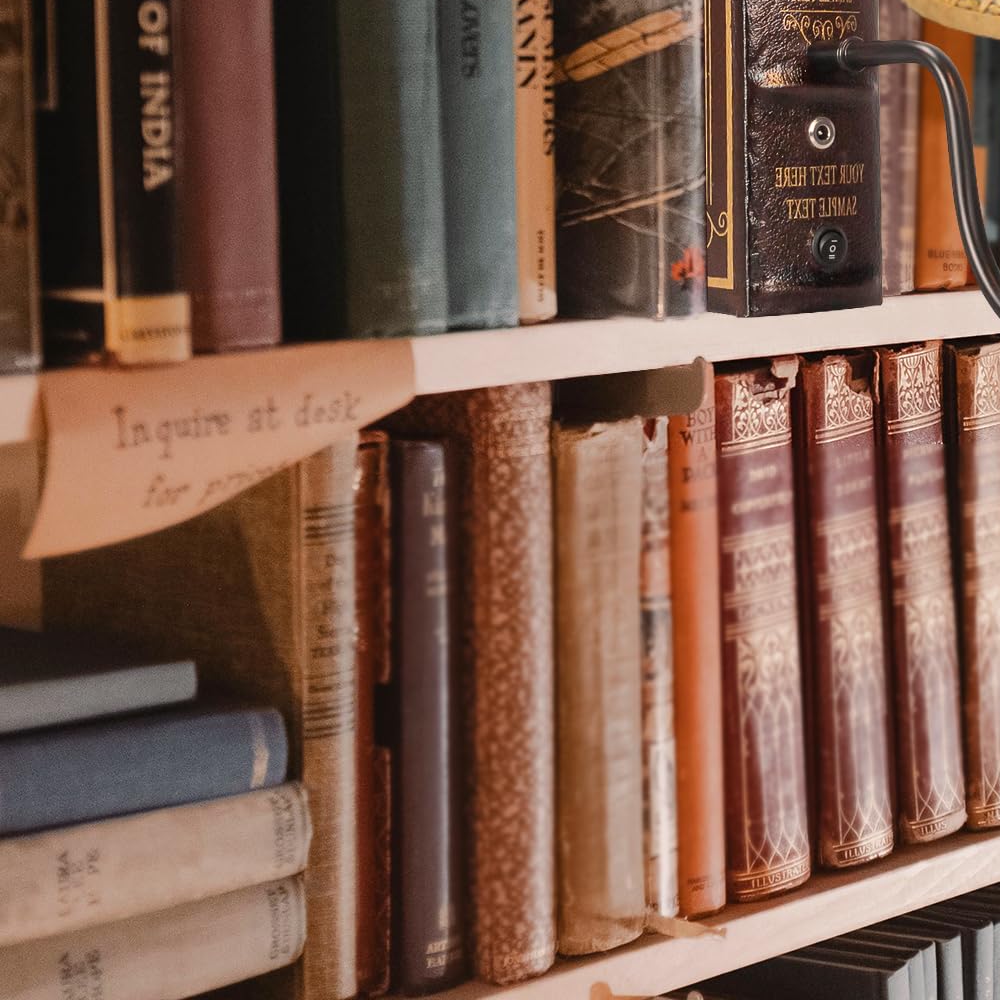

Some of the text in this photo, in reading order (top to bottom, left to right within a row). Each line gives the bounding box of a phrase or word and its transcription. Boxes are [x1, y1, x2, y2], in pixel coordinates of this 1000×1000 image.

[137, 0, 170, 57] OF
[139, 71, 173, 192] INDIA
[110, 392, 362, 461] Inquire at desk
